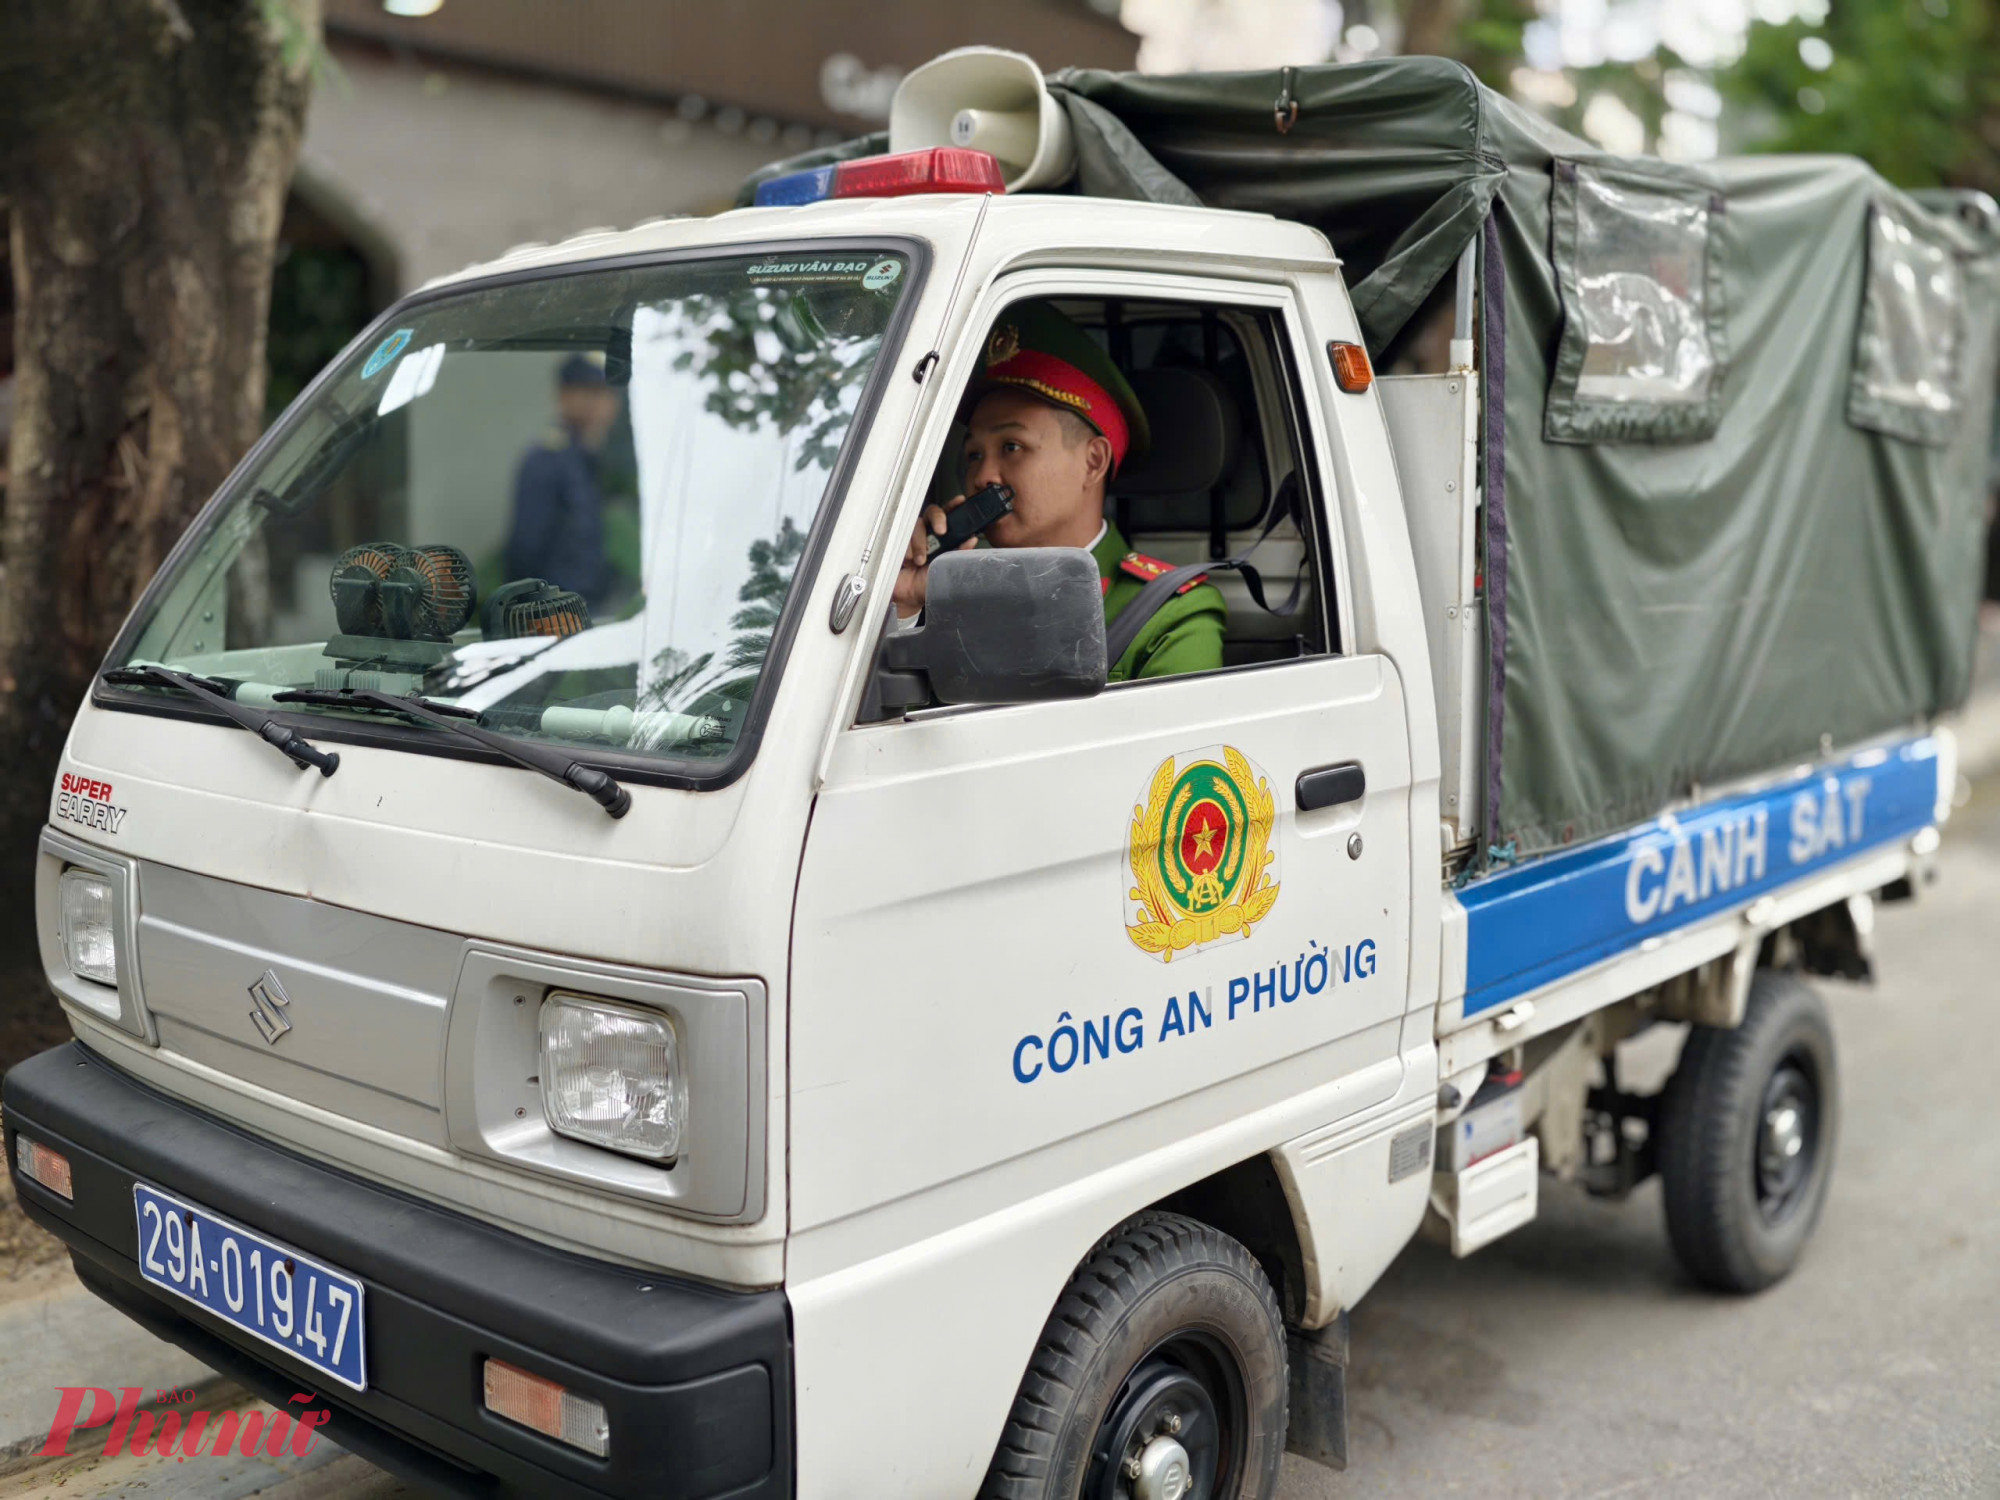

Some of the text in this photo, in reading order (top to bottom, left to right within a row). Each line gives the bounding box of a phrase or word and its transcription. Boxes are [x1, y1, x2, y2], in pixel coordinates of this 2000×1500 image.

[747, 263, 798, 275] SUZUKI
[832, 262, 867, 275] ĐẠO
[61, 773, 112, 802] SUPER
[57, 792, 127, 834] CARRY
[1012, 938, 1376, 1084] CÔNG AN PHƯỜNG
[143, 1200, 353, 1366] 29A-019.47
